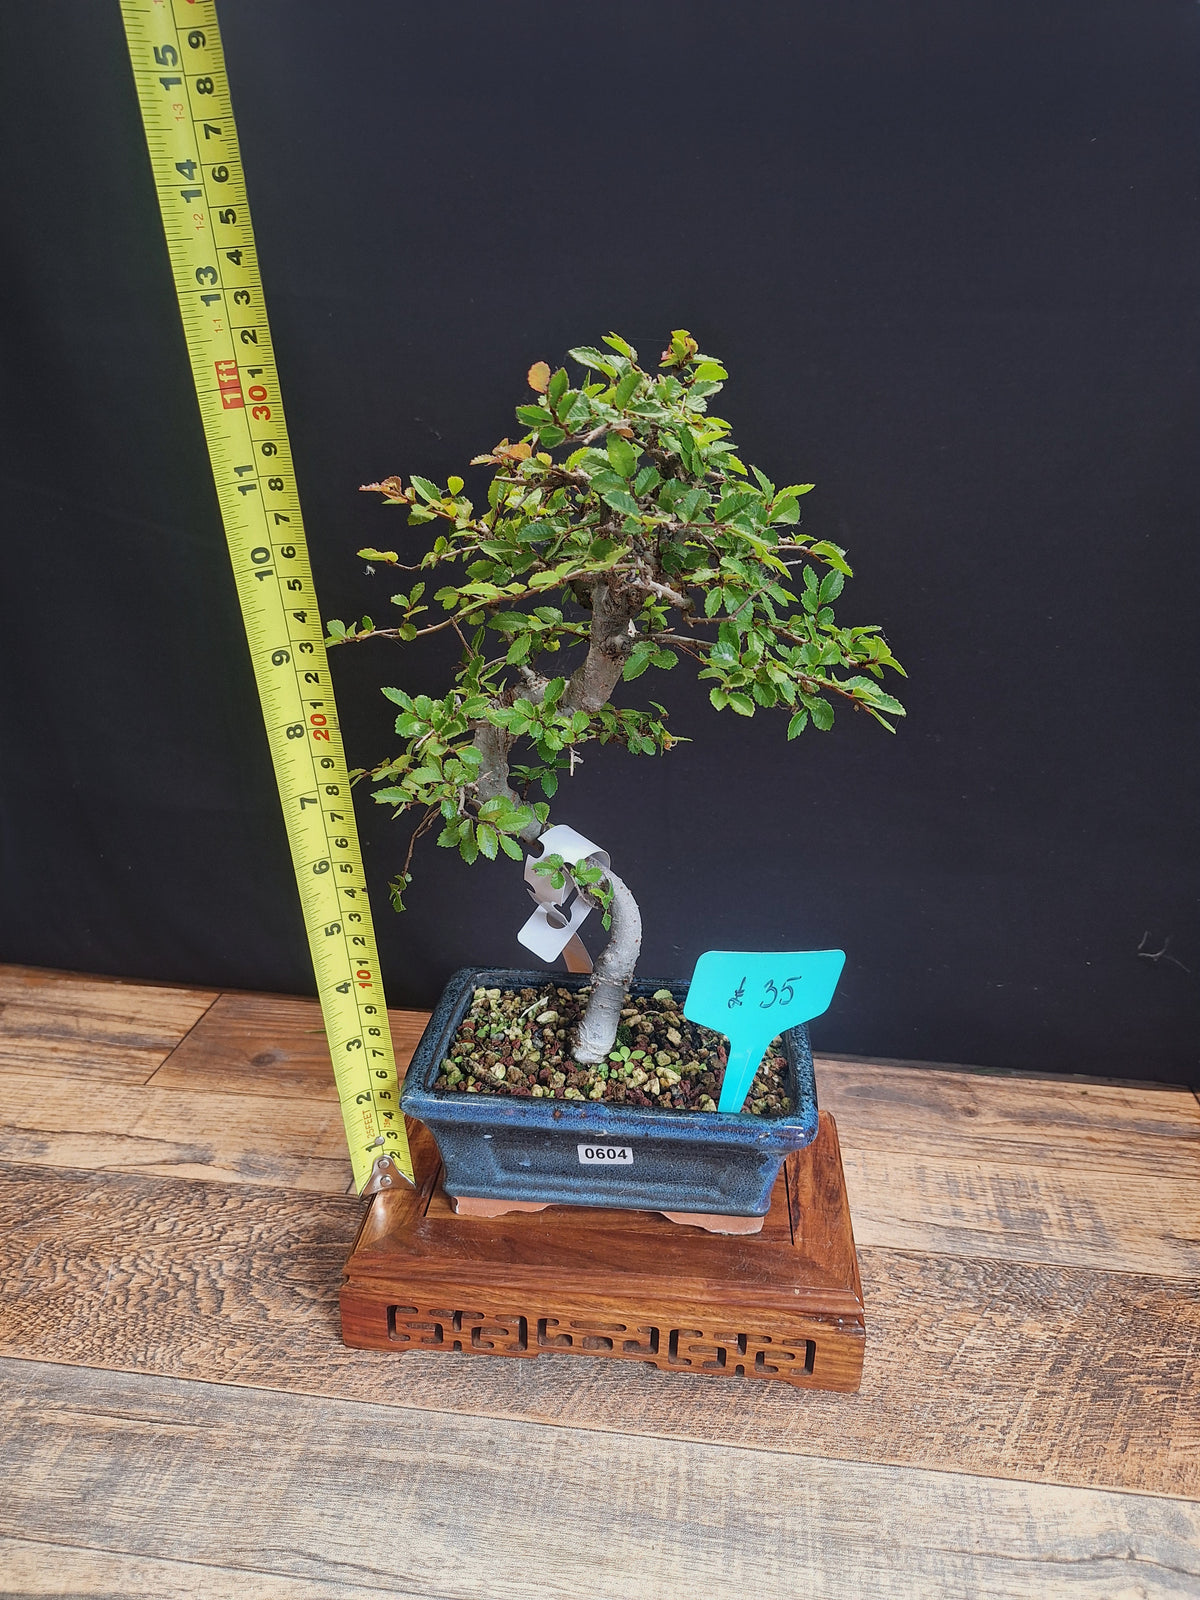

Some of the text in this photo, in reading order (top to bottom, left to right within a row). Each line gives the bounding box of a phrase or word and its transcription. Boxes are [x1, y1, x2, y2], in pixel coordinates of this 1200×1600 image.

[188, 30, 207, 49] 9
[154, 44, 182, 91] 15
[196, 77, 214, 95] 8
[173, 103, 185, 122] 1-3
[204, 123, 222, 140] 7
[175, 159, 202, 203] 14
[212, 166, 229, 183] 6
[193, 213, 205, 231] 1-2
[219, 208, 237, 224] 5
[226, 249, 243, 266] 4
[195, 266, 222, 307] 13
[233, 290, 251, 305] 3
[212, 319, 224, 333] 1-1
[240, 329, 258, 345] 2
[248, 385, 271, 421] 30
[261, 442, 278, 457] 9
[233, 464, 257, 496] 11
[268, 477, 284, 491] 8
[274, 512, 290, 525] 7
[281, 545, 296, 559] 6
[250, 547, 274, 582] 10
[287, 579, 303, 591] 5
[293, 611, 308, 624] 4
[299, 642, 314, 654] 3
[271, 650, 291, 666] 9
[304, 672, 320, 684] 2
[286, 724, 305, 740] 8
[310, 714, 330, 741] 20
[321, 758, 335, 769] 9
[326, 785, 340, 796] 8
[300, 797, 318, 810] 7
[330, 812, 344, 822] 7
[335, 838, 349, 848] 6
[312, 860, 330, 875] 6
[340, 864, 353, 874] 5
[344, 888, 357, 899] 4
[349, 912, 362, 922] 3
[325, 923, 342, 937] 5
[352, 936, 366, 946] 2
[357, 970, 373, 989] 10
[336, 982, 351, 994] 4
[759, 976, 802, 1009] 35
[365, 1005, 378, 1015] 9
[369, 1027, 381, 1037] 8
[346, 1038, 362, 1052] 3
[372, 1050, 385, 1058] 7
[376, 1070, 388, 1079] 6
[356, 1091, 372, 1105] 2
[379, 1091, 392, 1100] 5
[383, 1111, 394, 1120] 4
[386, 1131, 398, 1140] 3
[390, 1151, 401, 1159] 2
[584, 1147, 628, 1160] 0604
